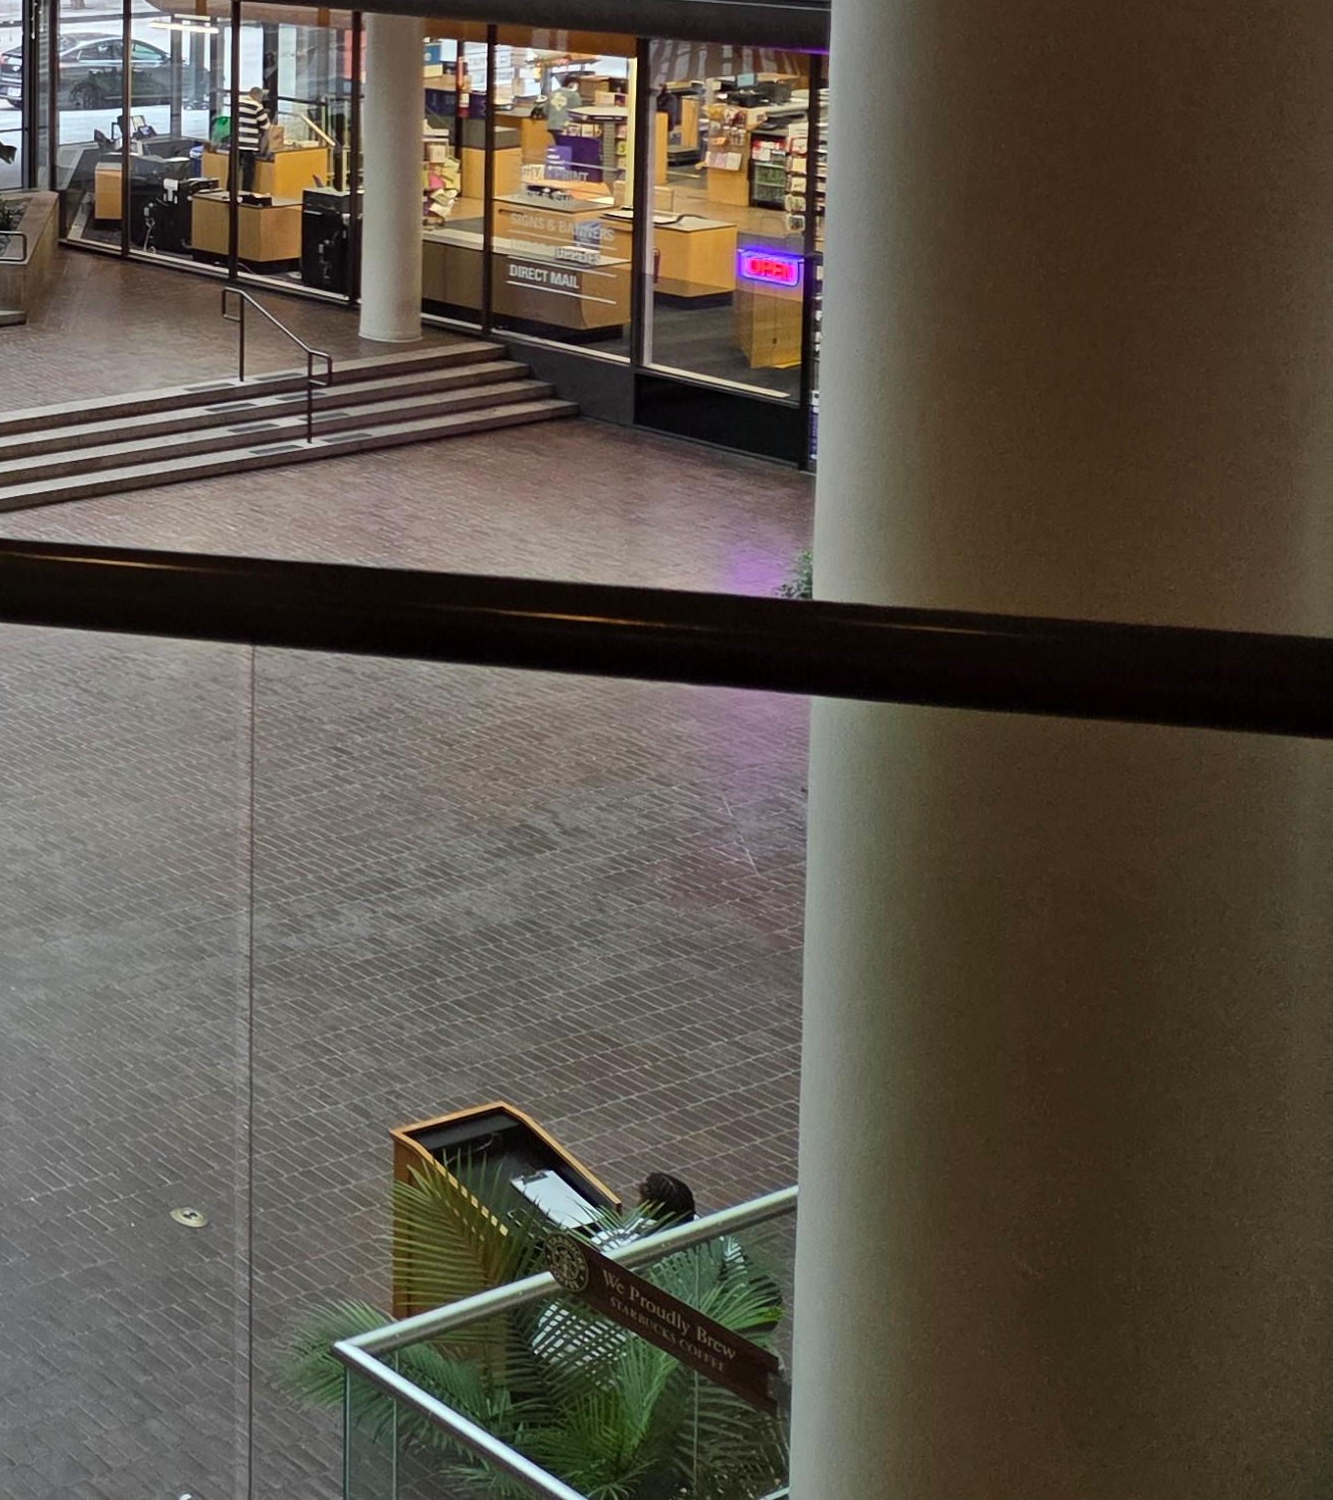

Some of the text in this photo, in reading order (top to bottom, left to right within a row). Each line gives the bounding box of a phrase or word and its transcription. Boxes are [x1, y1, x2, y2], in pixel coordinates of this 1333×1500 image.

[510, 213, 615, 241] SIGNS & BANNERS
[508, 264, 580, 289] DIRECT MAIL
[748, 257, 795, 282] OPEN
[602, 1268, 737, 1360] We Proudly Brew
[609, 1296, 725, 1372] STARBUCKS COFFEE
